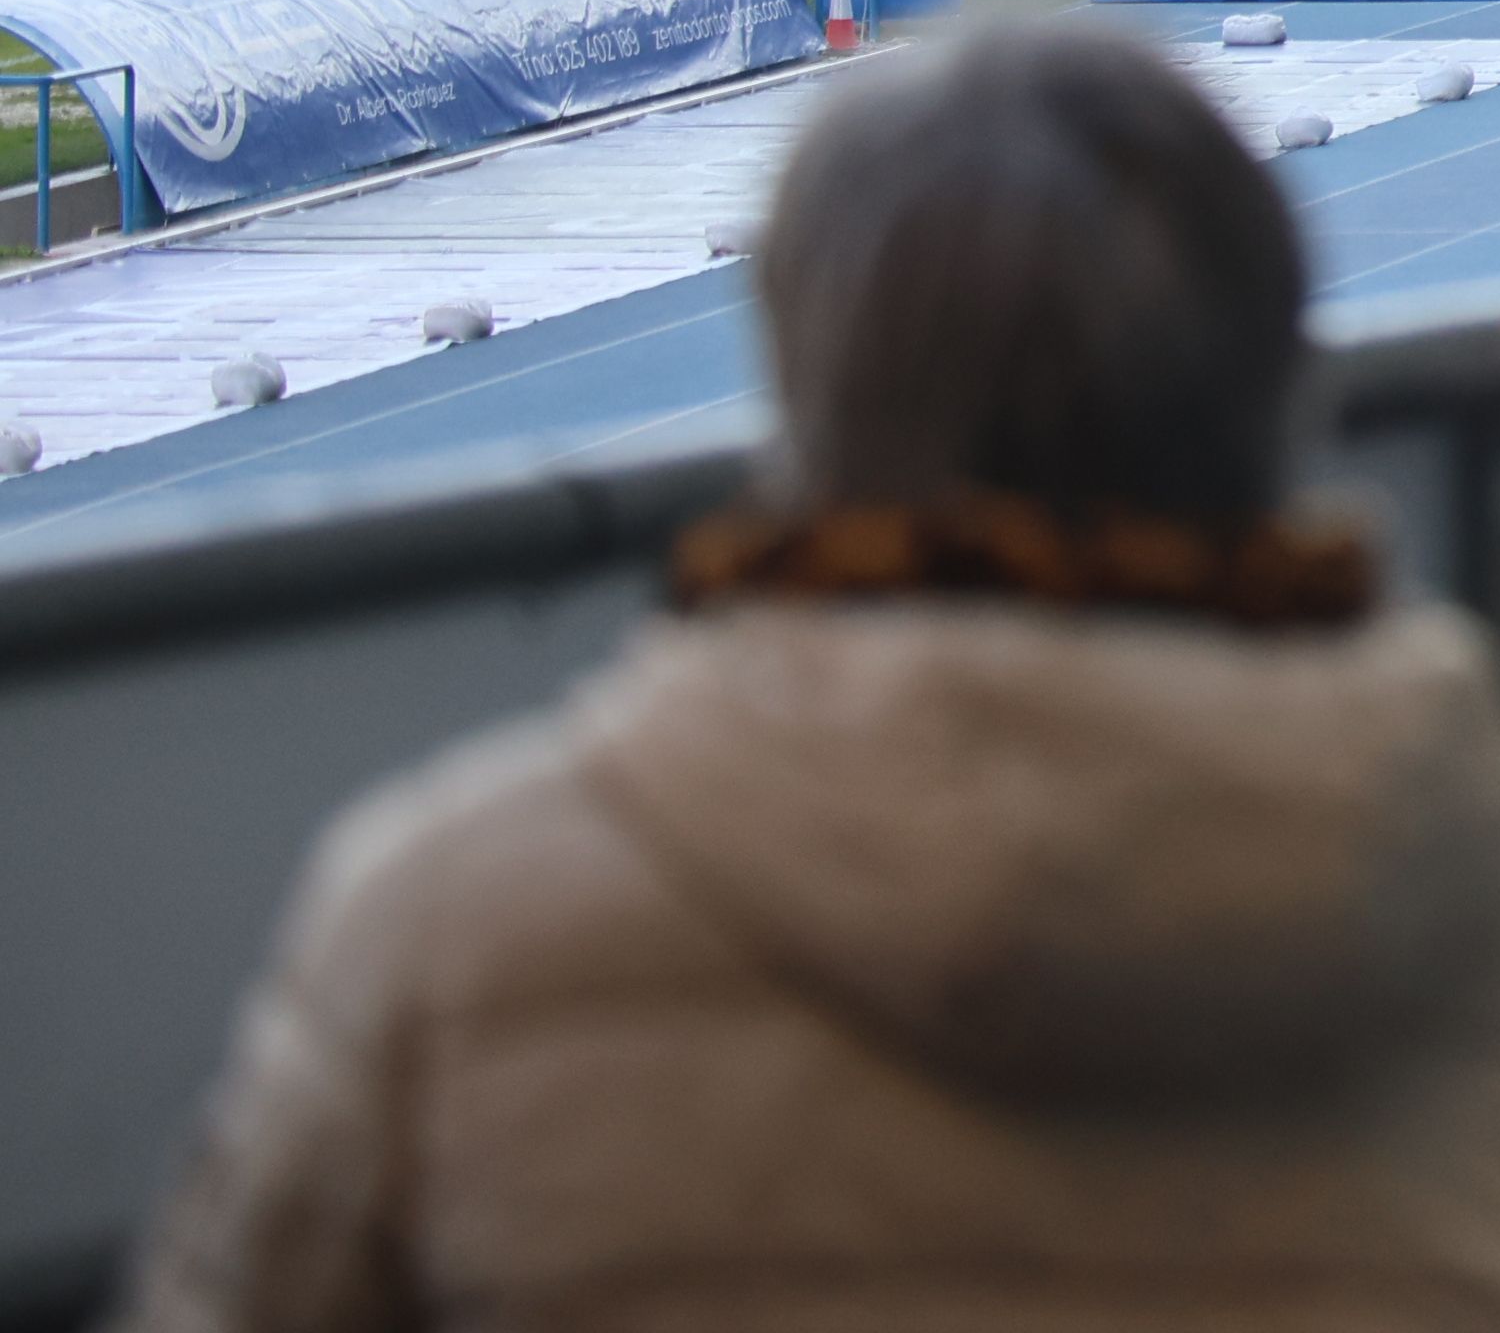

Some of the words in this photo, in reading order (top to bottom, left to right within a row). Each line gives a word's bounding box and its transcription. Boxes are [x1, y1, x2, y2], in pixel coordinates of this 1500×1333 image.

[557, 36, 586, 72] 625
[586, 31, 616, 64] 402
[616, 27, 641, 57] 189
[336, 100, 355, 126] Dr.
